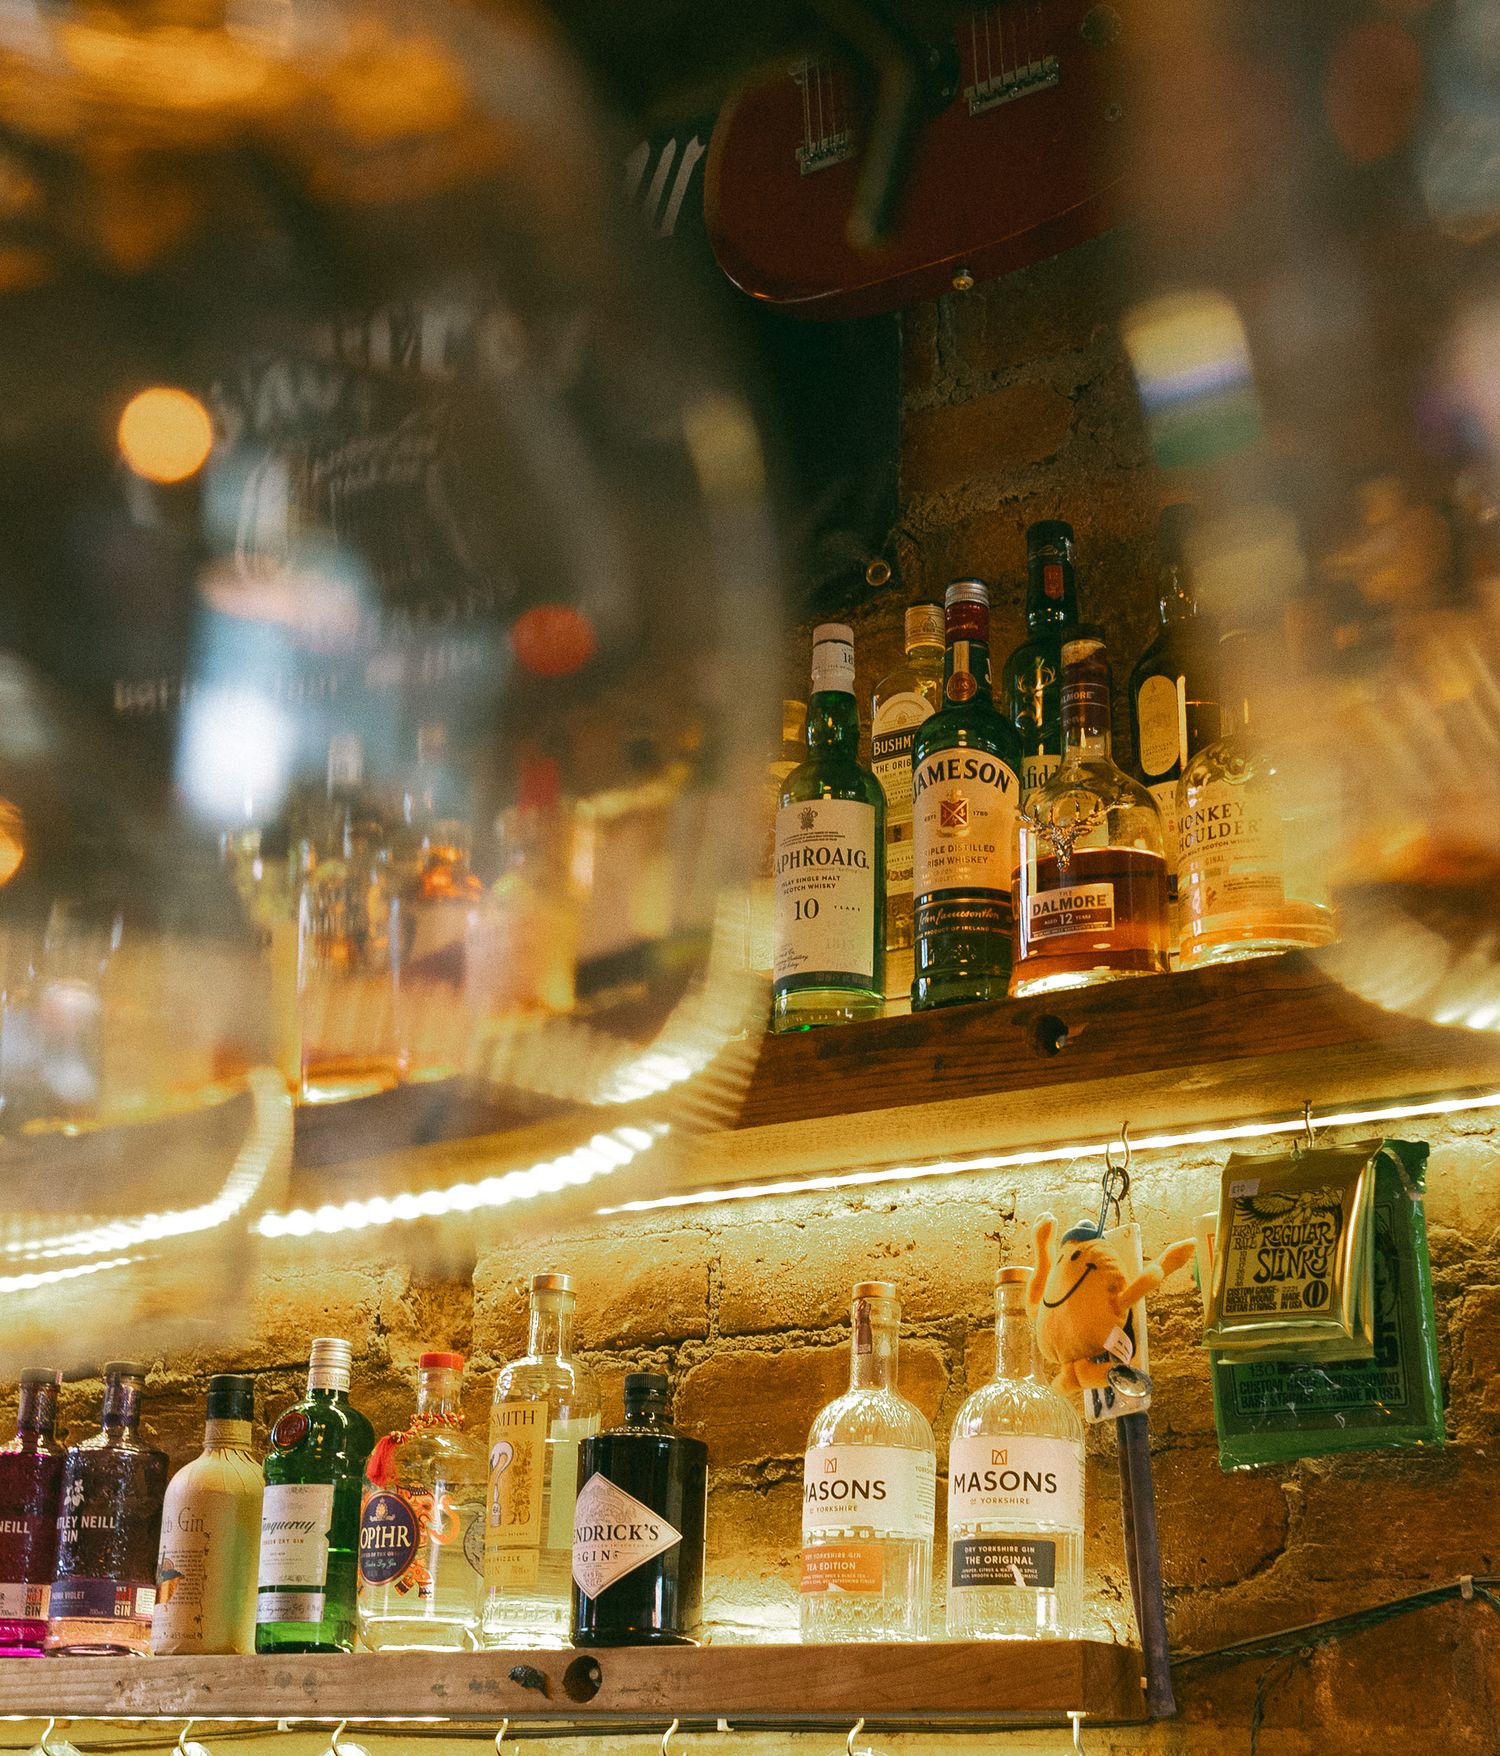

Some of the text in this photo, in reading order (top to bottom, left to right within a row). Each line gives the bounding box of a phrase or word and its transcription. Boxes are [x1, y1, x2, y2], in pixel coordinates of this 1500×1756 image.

[874, 735, 915, 756] BUSHM
[876, 763, 889, 775] THE
[913, 758, 1010, 804] JAMESON
[948, 844, 995, 854] DISTILLED
[947, 855, 989, 865] WHISKEY
[796, 875, 819, 884] SINGLE
[783, 883, 836, 896] SCOTCH WHISKY
[794, 897, 820, 921] 10
[1033, 894, 1107, 917] DALMORE
[1060, 913, 1073, 925] 12
[1260, 1221, 1334, 1248] REGULAR
[954, 1470, 1057, 1496] MASONS
[980, 1497, 1031, 1505] YORKSHIRE
[816, 1504, 858, 1513] YORKSHIRE
[81, 1515, 116, 1529] NEILL
[178, 1506, 204, 1533] Gin
[62, 1529, 79, 1543] GIN
[360, 1524, 412, 1550] OPIHR
[964, 1545, 1036, 1554] DRY YORKSHIRE GIN
[582, 1550, 611, 1563] GIN
[965, 1555, 1034, 1566] THE ORIGINAL
[819, 1562, 856, 1571] EDITION
[64, 1590, 86, 1600] VIOLET
[25, 1604, 41, 1618] GIN
[114, 1604, 131, 1617] GIN
